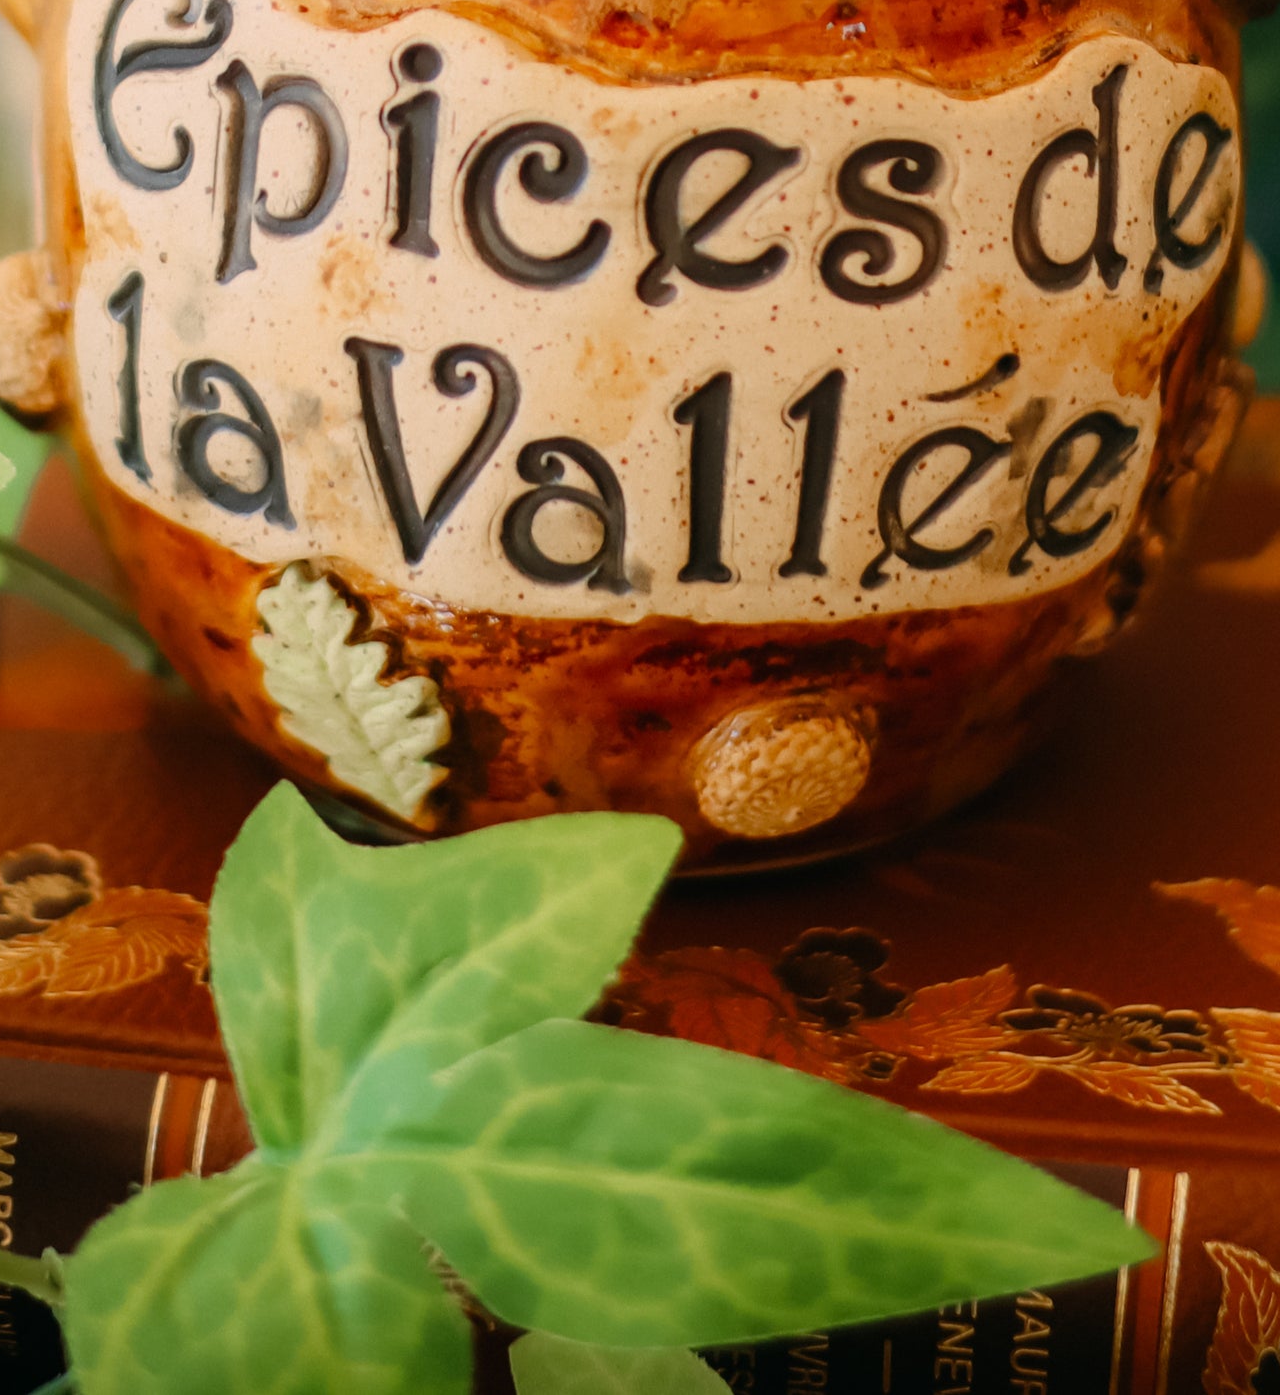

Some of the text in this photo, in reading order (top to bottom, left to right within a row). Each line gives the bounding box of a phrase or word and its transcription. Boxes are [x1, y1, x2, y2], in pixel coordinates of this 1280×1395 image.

[1011, 63, 1235, 293] de
[107, 271, 1139, 595] la Vallée
